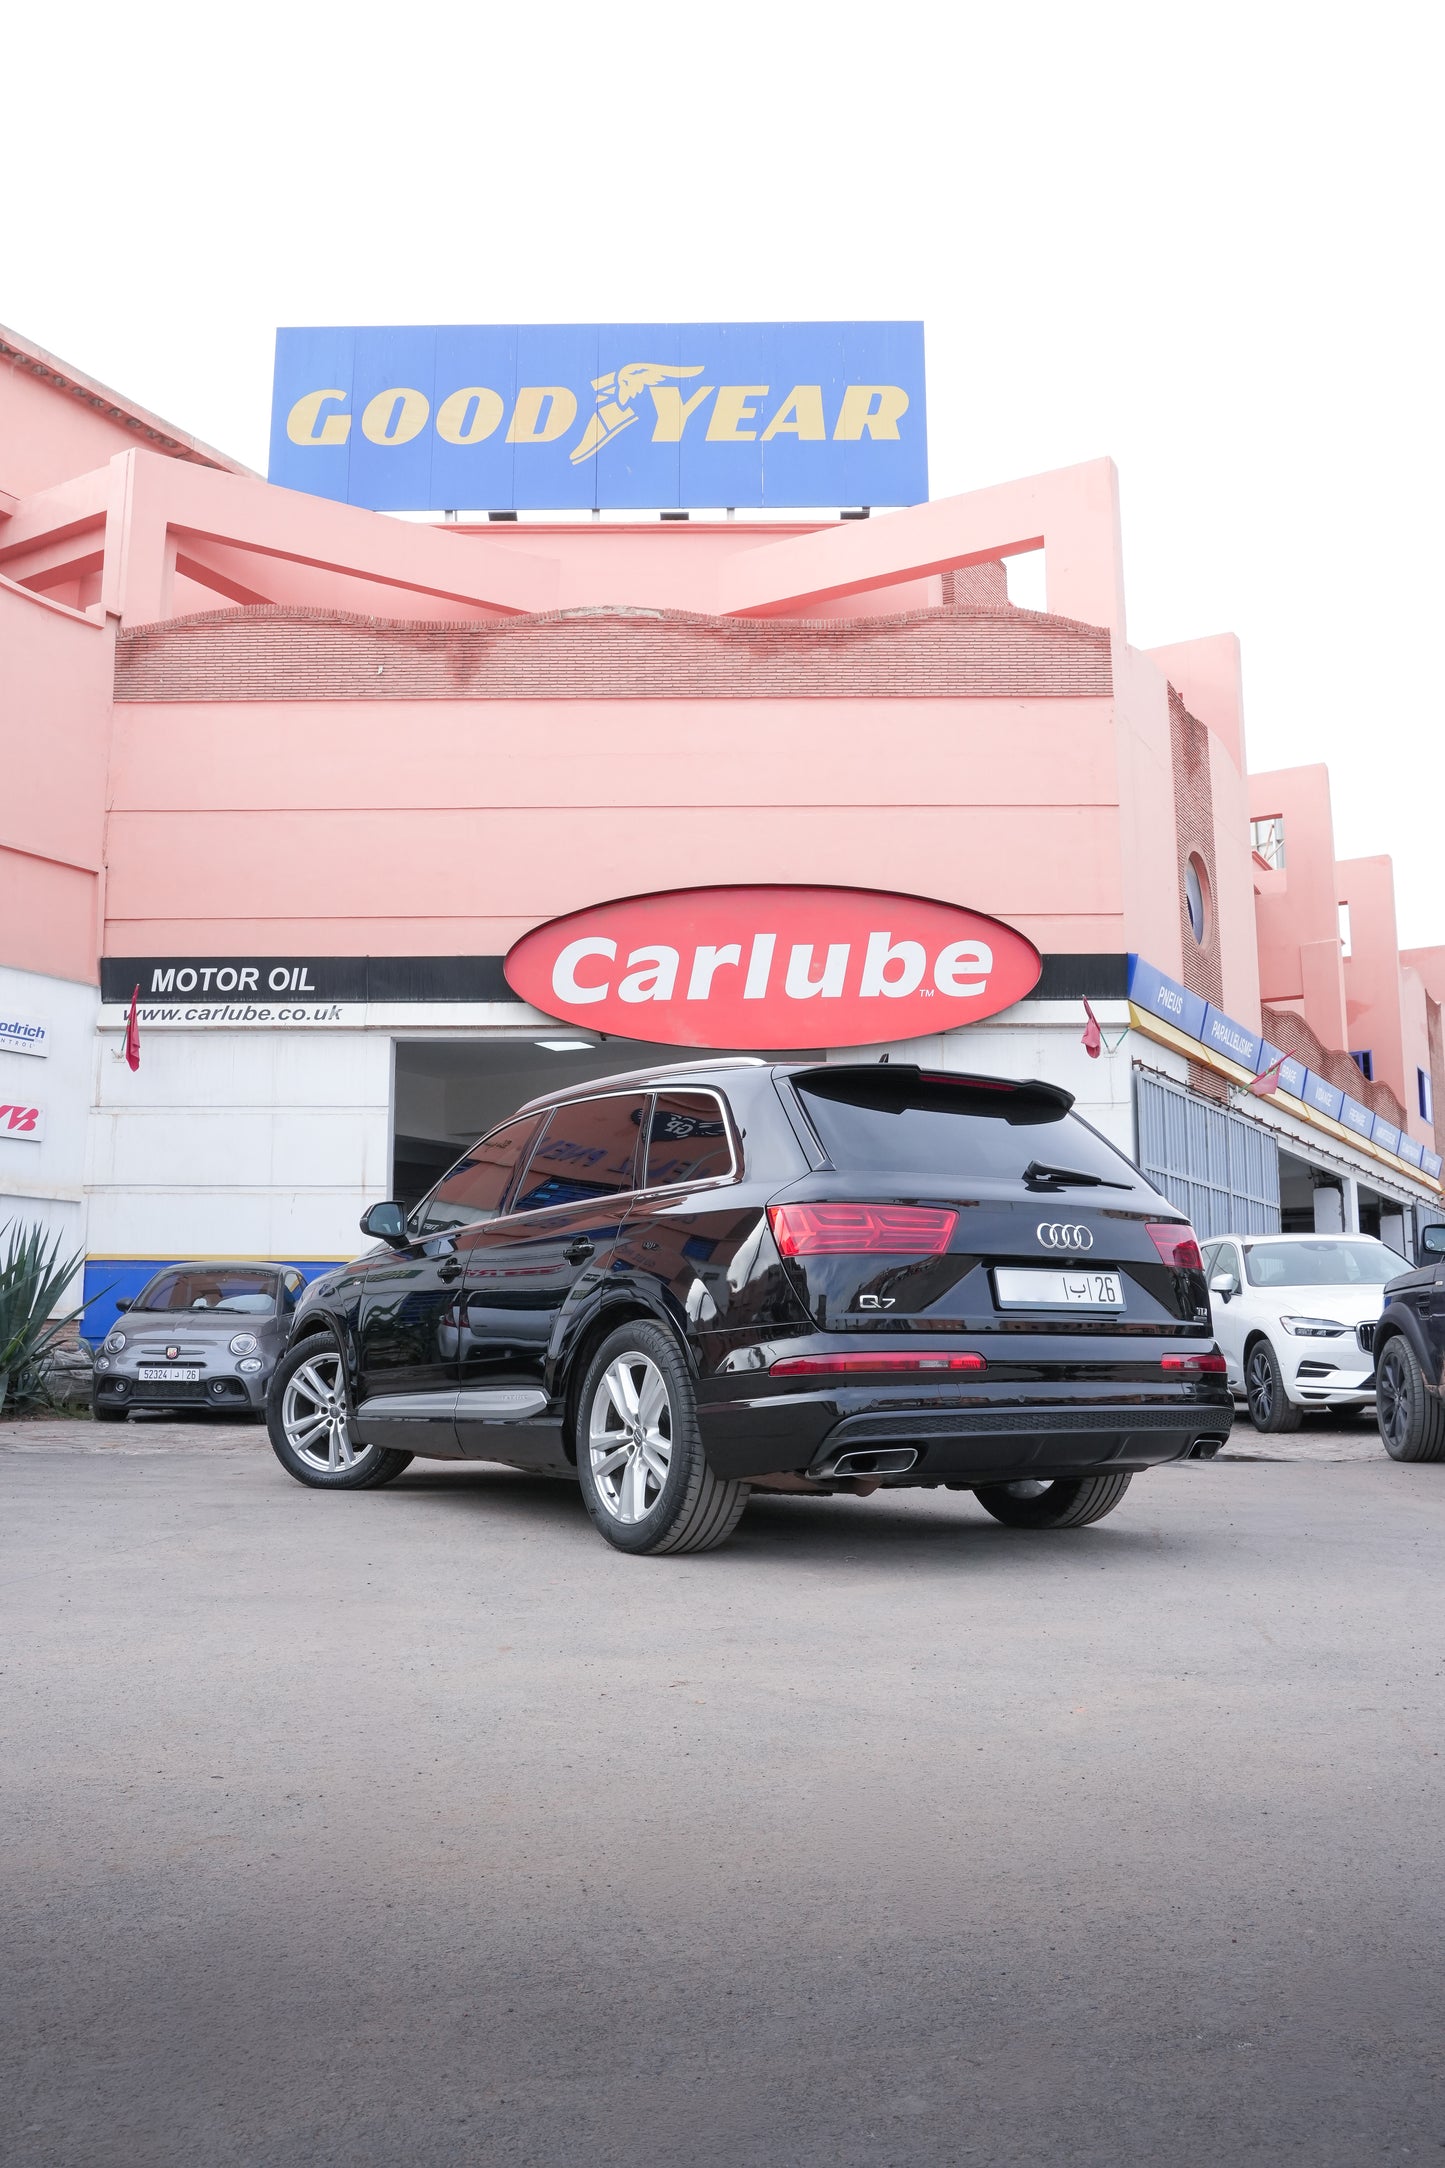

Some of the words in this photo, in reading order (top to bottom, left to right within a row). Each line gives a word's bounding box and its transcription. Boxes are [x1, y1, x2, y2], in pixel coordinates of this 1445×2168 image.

[151, 967, 260, 992] MOTOR
[268, 967, 316, 991] OIL
[552, 932, 993, 1004] Carlube
[1157, 986, 1183, 1014] PNEUS
[1211, 1020, 1254, 1058] PARALLELISME
[859, 1294, 896, 1309] Q7
[1094, 1276, 1116, 1303] 26
[144, 1369, 168, 1380] 52324
[186, 1370, 196, 1380] 26
